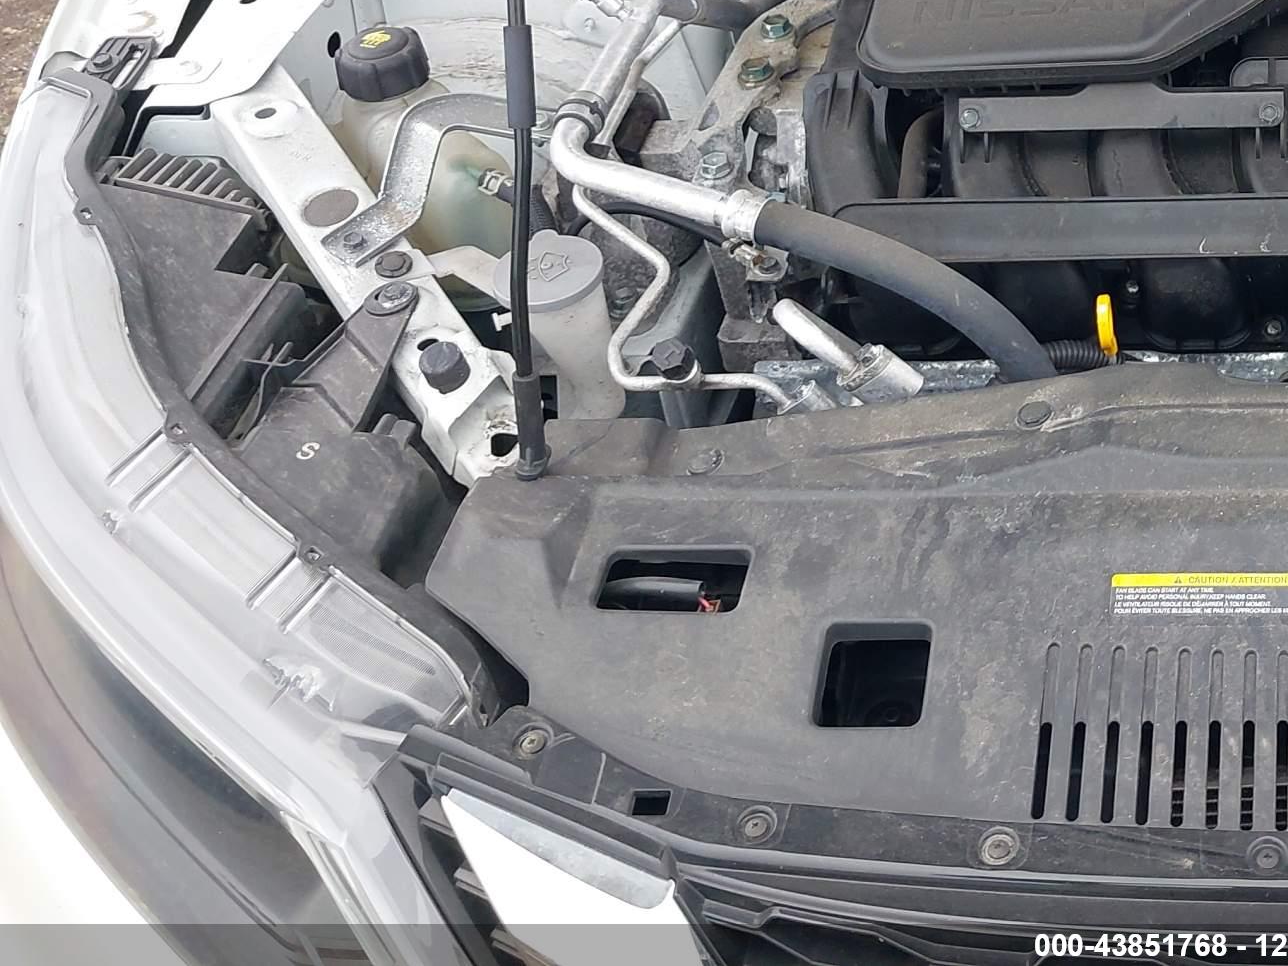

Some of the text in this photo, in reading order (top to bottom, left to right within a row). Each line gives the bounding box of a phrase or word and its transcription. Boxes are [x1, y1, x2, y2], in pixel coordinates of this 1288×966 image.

[296, 442, 320, 460] S
[1188, 576, 1229, 584] CAUTION
[1239, 576, 1287, 584] ATTENTION
